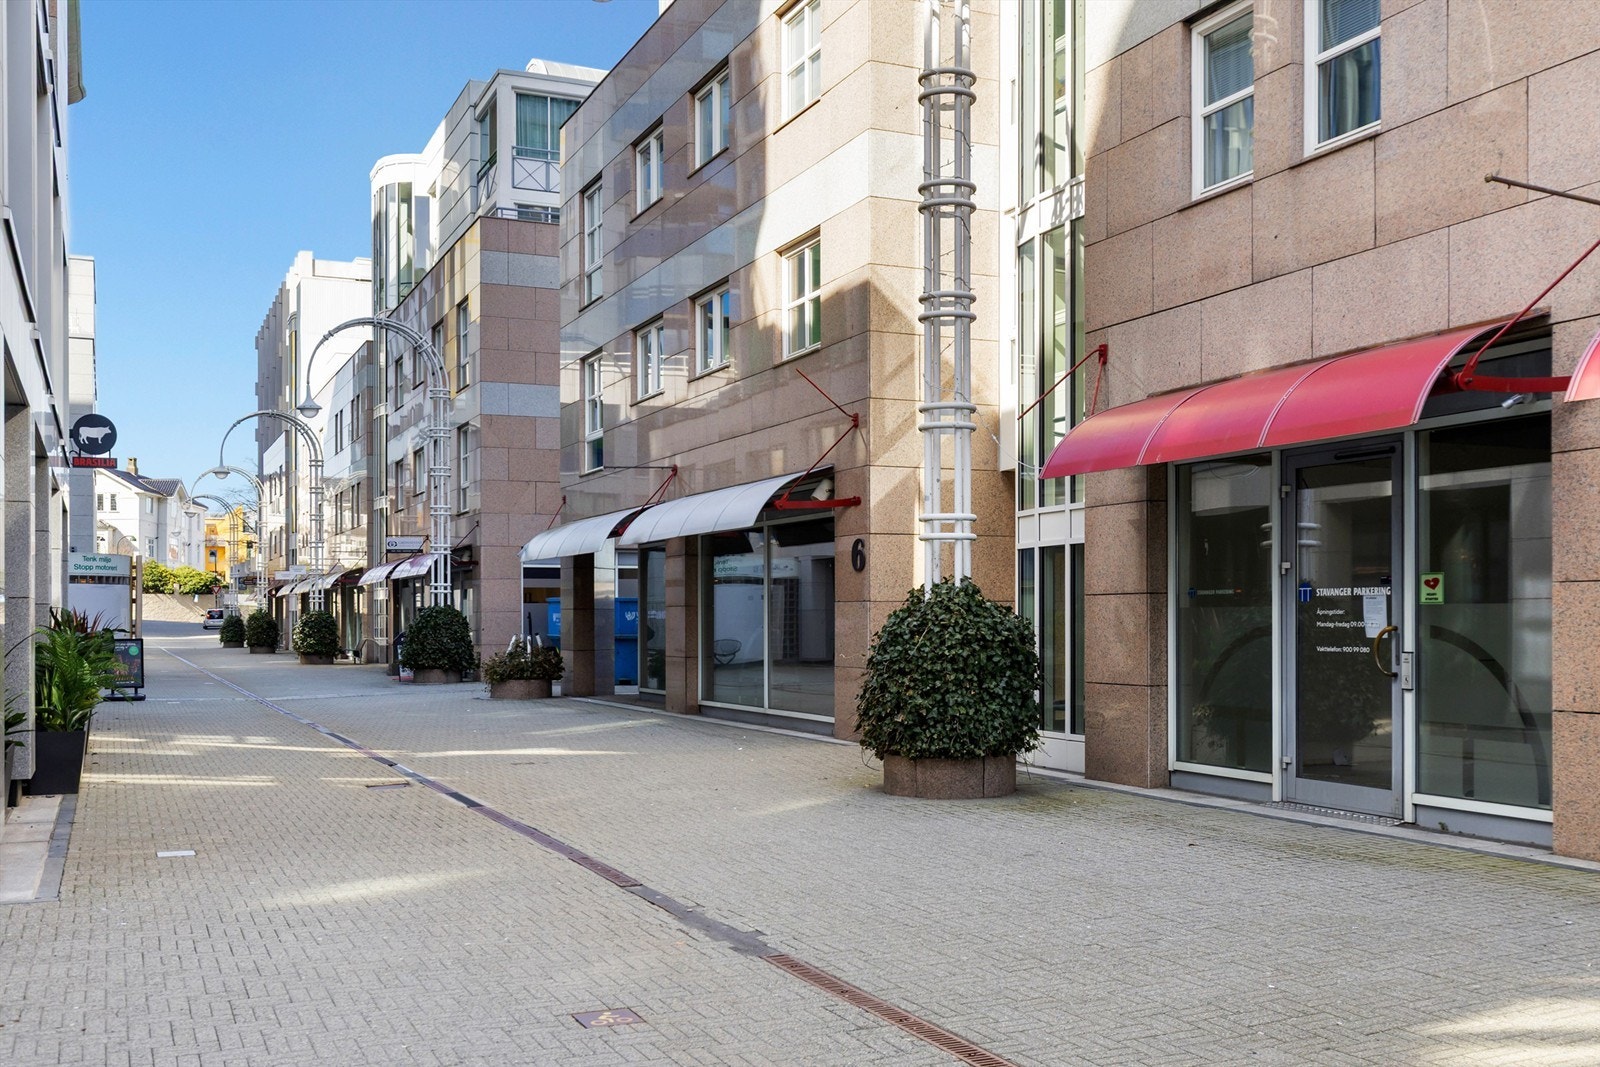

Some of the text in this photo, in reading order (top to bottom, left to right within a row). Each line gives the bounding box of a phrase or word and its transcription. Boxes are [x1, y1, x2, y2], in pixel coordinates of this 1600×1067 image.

[74, 457, 115, 467] BRASILIA
[851, 538, 866, 572] 6
[1316, 587, 1391, 596] STAVANGER PARKERING
[1316, 608, 1346, 616] Åpningstider:
